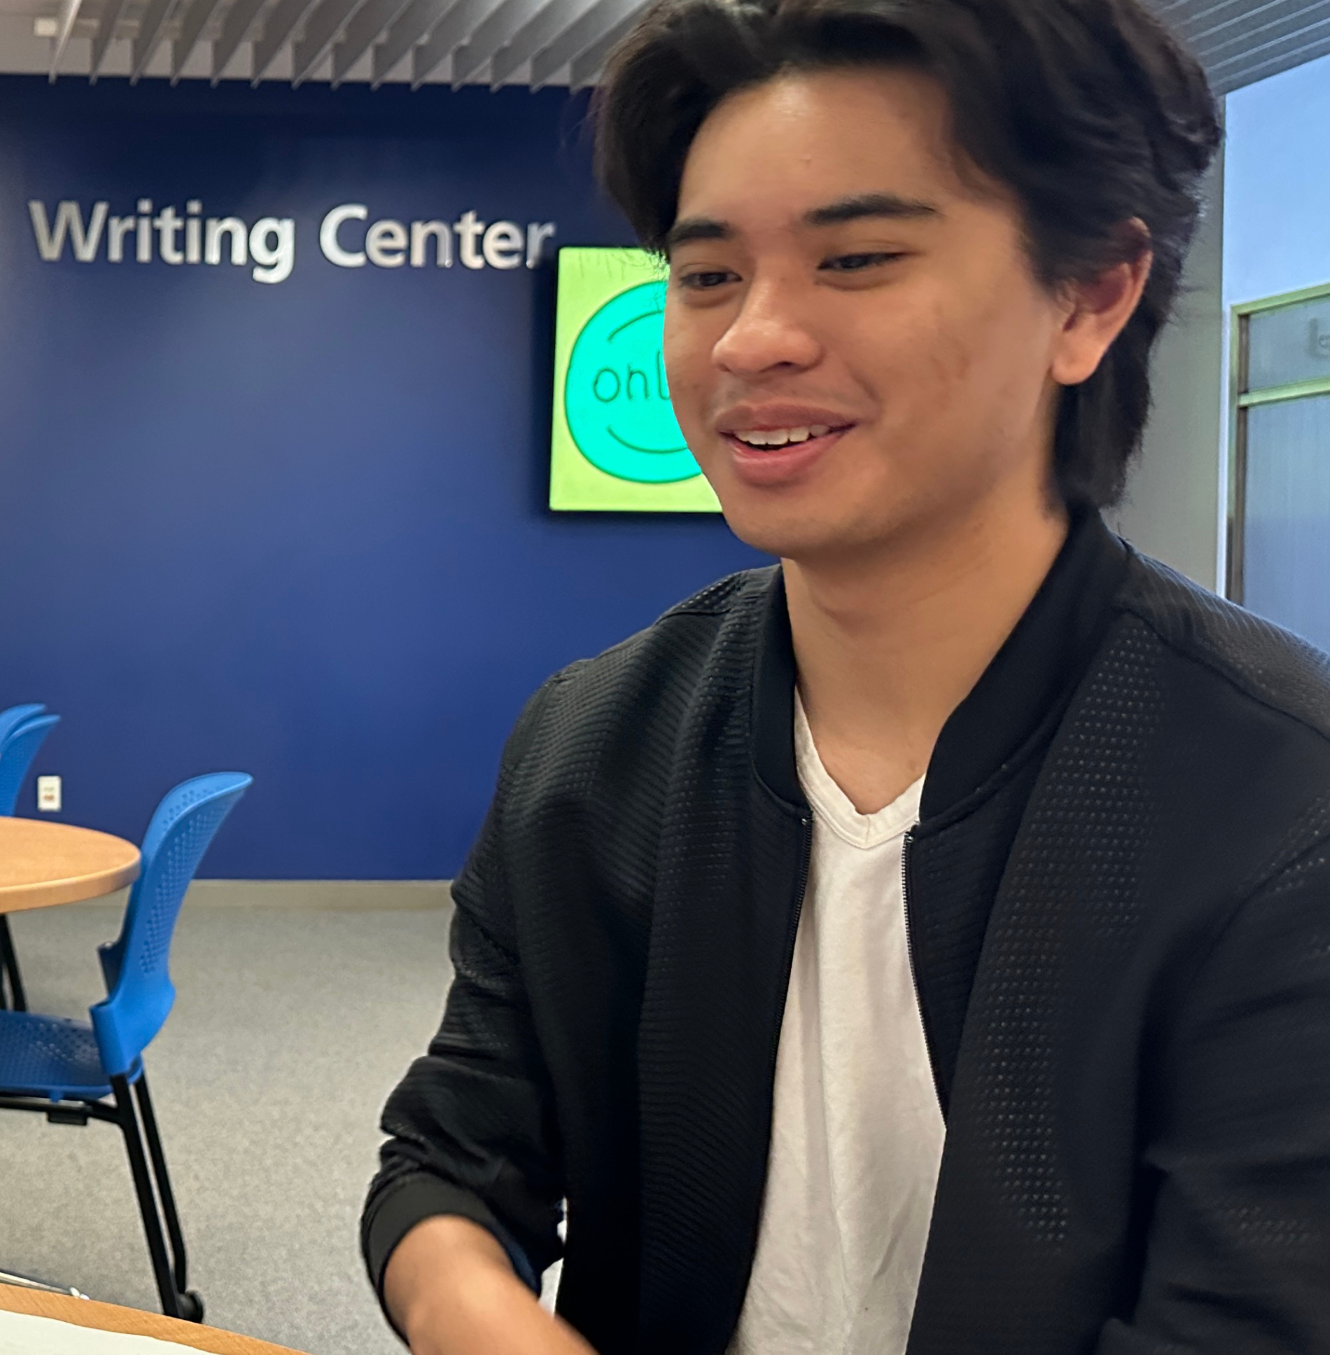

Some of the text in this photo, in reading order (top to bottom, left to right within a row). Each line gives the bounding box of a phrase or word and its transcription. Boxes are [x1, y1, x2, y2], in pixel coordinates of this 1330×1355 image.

[27, 199, 557, 284] Writing Center
[593, 350, 671, 403] onl
